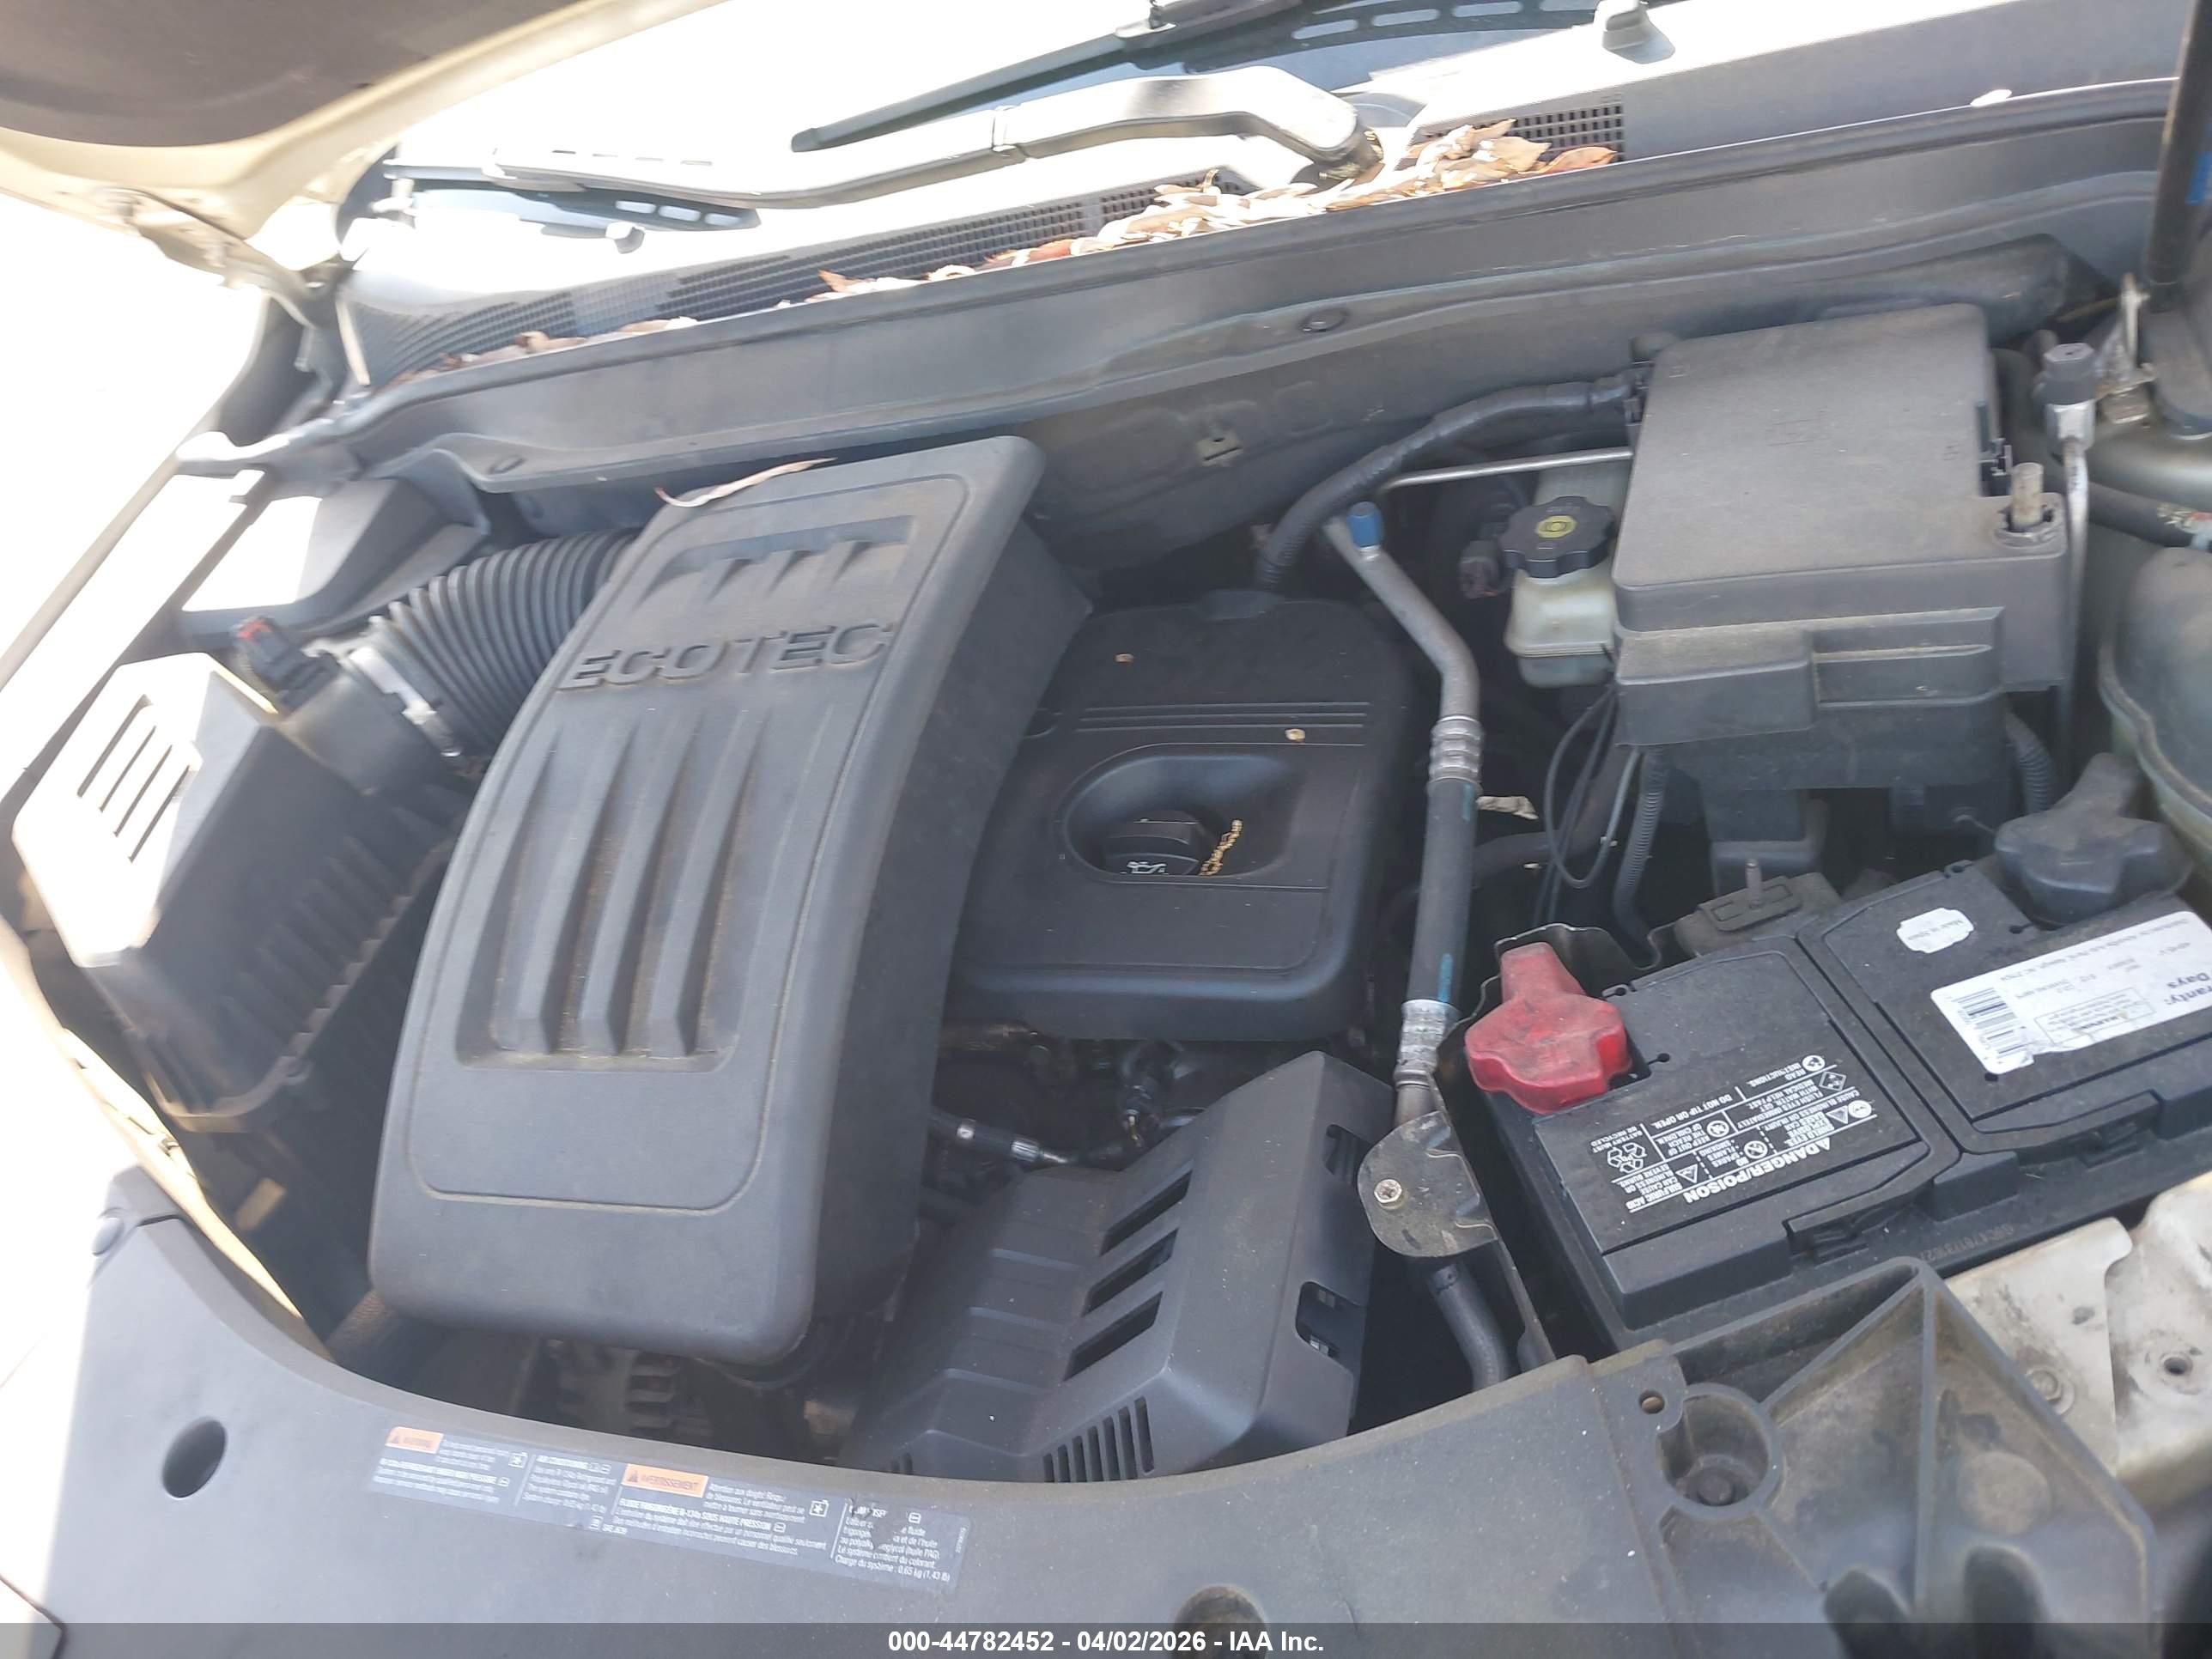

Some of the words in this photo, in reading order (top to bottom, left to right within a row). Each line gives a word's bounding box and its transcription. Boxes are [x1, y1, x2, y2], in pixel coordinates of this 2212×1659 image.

[554, 621, 895, 692] ECOTEC
[2166, 971, 2210, 989] Days
[1784, 1068, 1806, 1080] READ
[1799, 1085, 1818, 1096] WITH
[1718, 1094, 1732, 1103] DO
[1766, 1091, 1784, 1102] HELP
[1703, 1099, 1720, 1110] NOT
[1675, 1111, 1689, 1120] OR
[1689, 1106, 1704, 1115] TIP
[1692, 1129, 1705, 1139] THE
[1677, 1142, 1692, 1152] OUT
[1735, 1157, 1748, 1166] NO
[1684, 1144, 1818, 1201] DANGER/POISON
[1662, 1176, 1677, 1186] CAN
[1625, 1184, 1636, 1193] OR
[1644, 1182, 1682, 1201] SULFURIC
[1626, 1196, 1644, 1209] ACID
